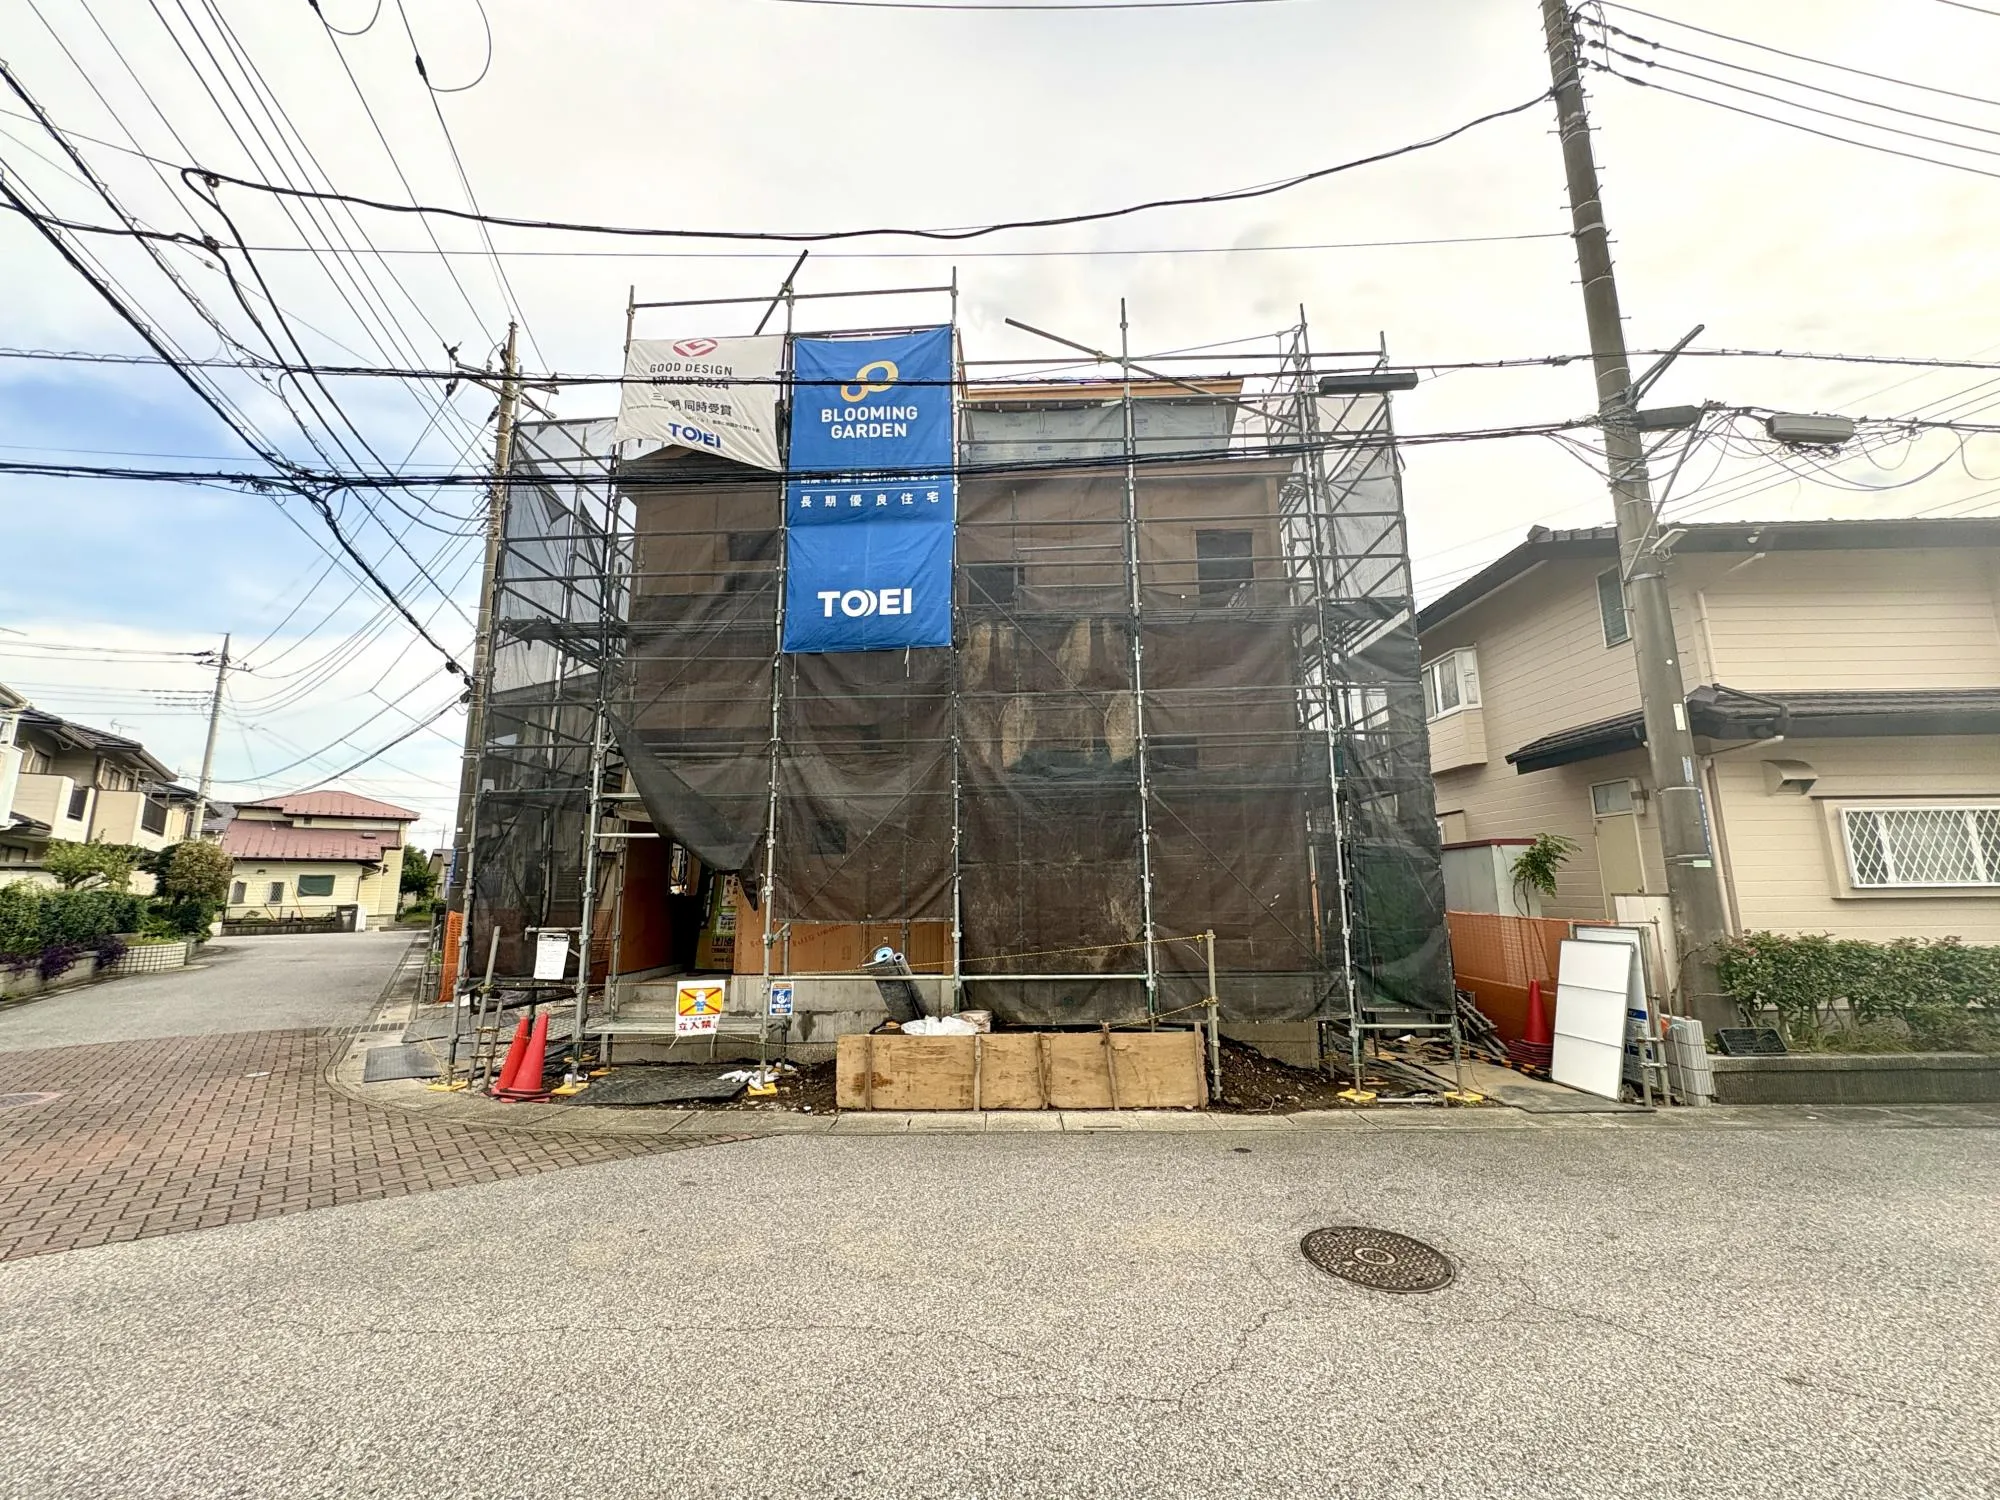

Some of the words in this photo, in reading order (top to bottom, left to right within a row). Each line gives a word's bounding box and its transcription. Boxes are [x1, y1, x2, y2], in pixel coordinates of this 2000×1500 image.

[650, 363, 681, 373] GOOD
[685, 363, 733, 376] DESIGN
[821, 406, 918, 423] BLOOMING
[831, 422, 907, 439] GARDEN
[800, 491, 939, 508] 長期優良住宅
